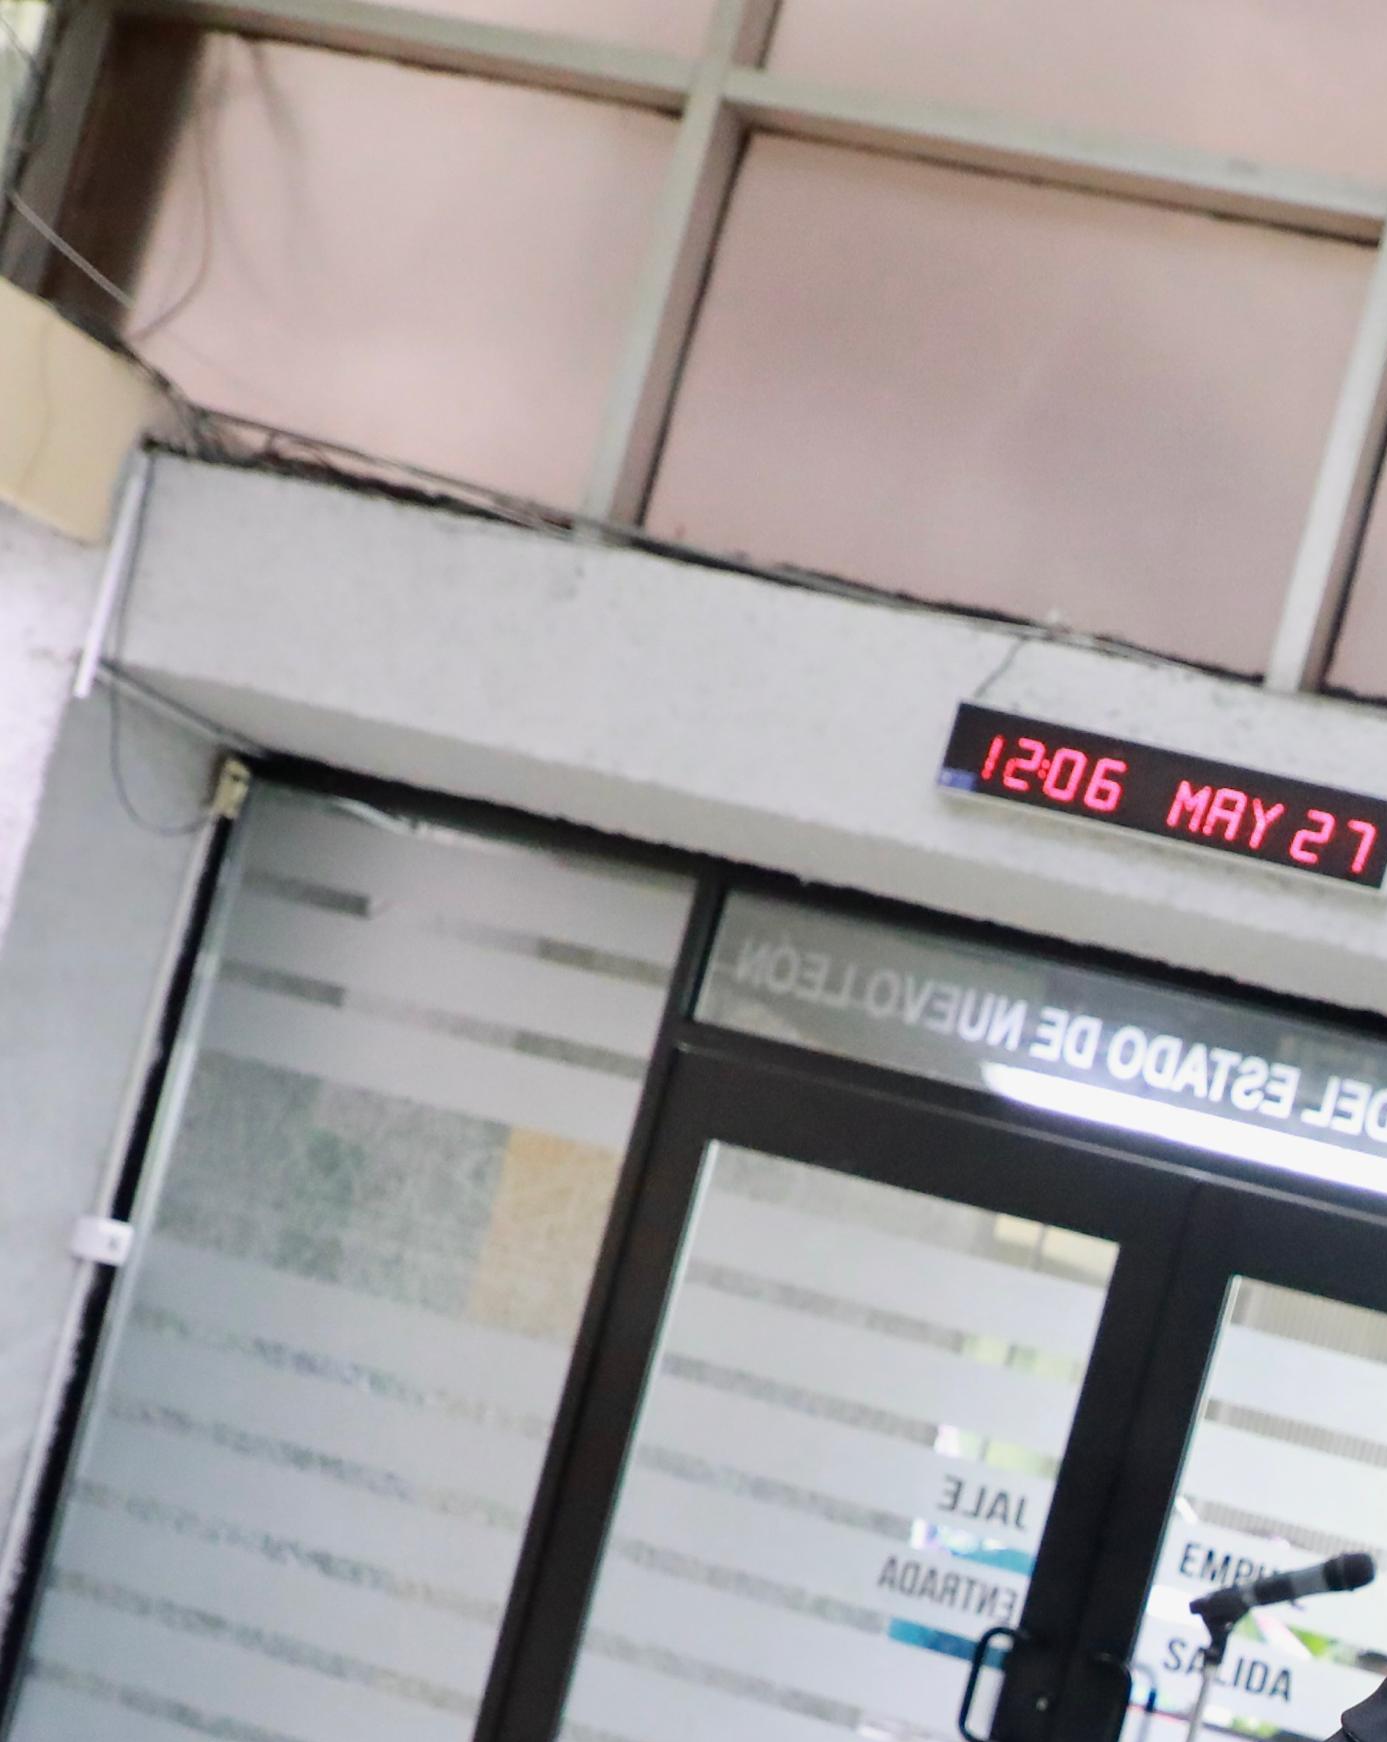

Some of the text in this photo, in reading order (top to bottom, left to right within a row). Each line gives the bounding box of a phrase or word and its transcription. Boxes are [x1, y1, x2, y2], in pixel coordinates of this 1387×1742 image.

[980, 733, 1379, 876] 12:06 MAY 27
